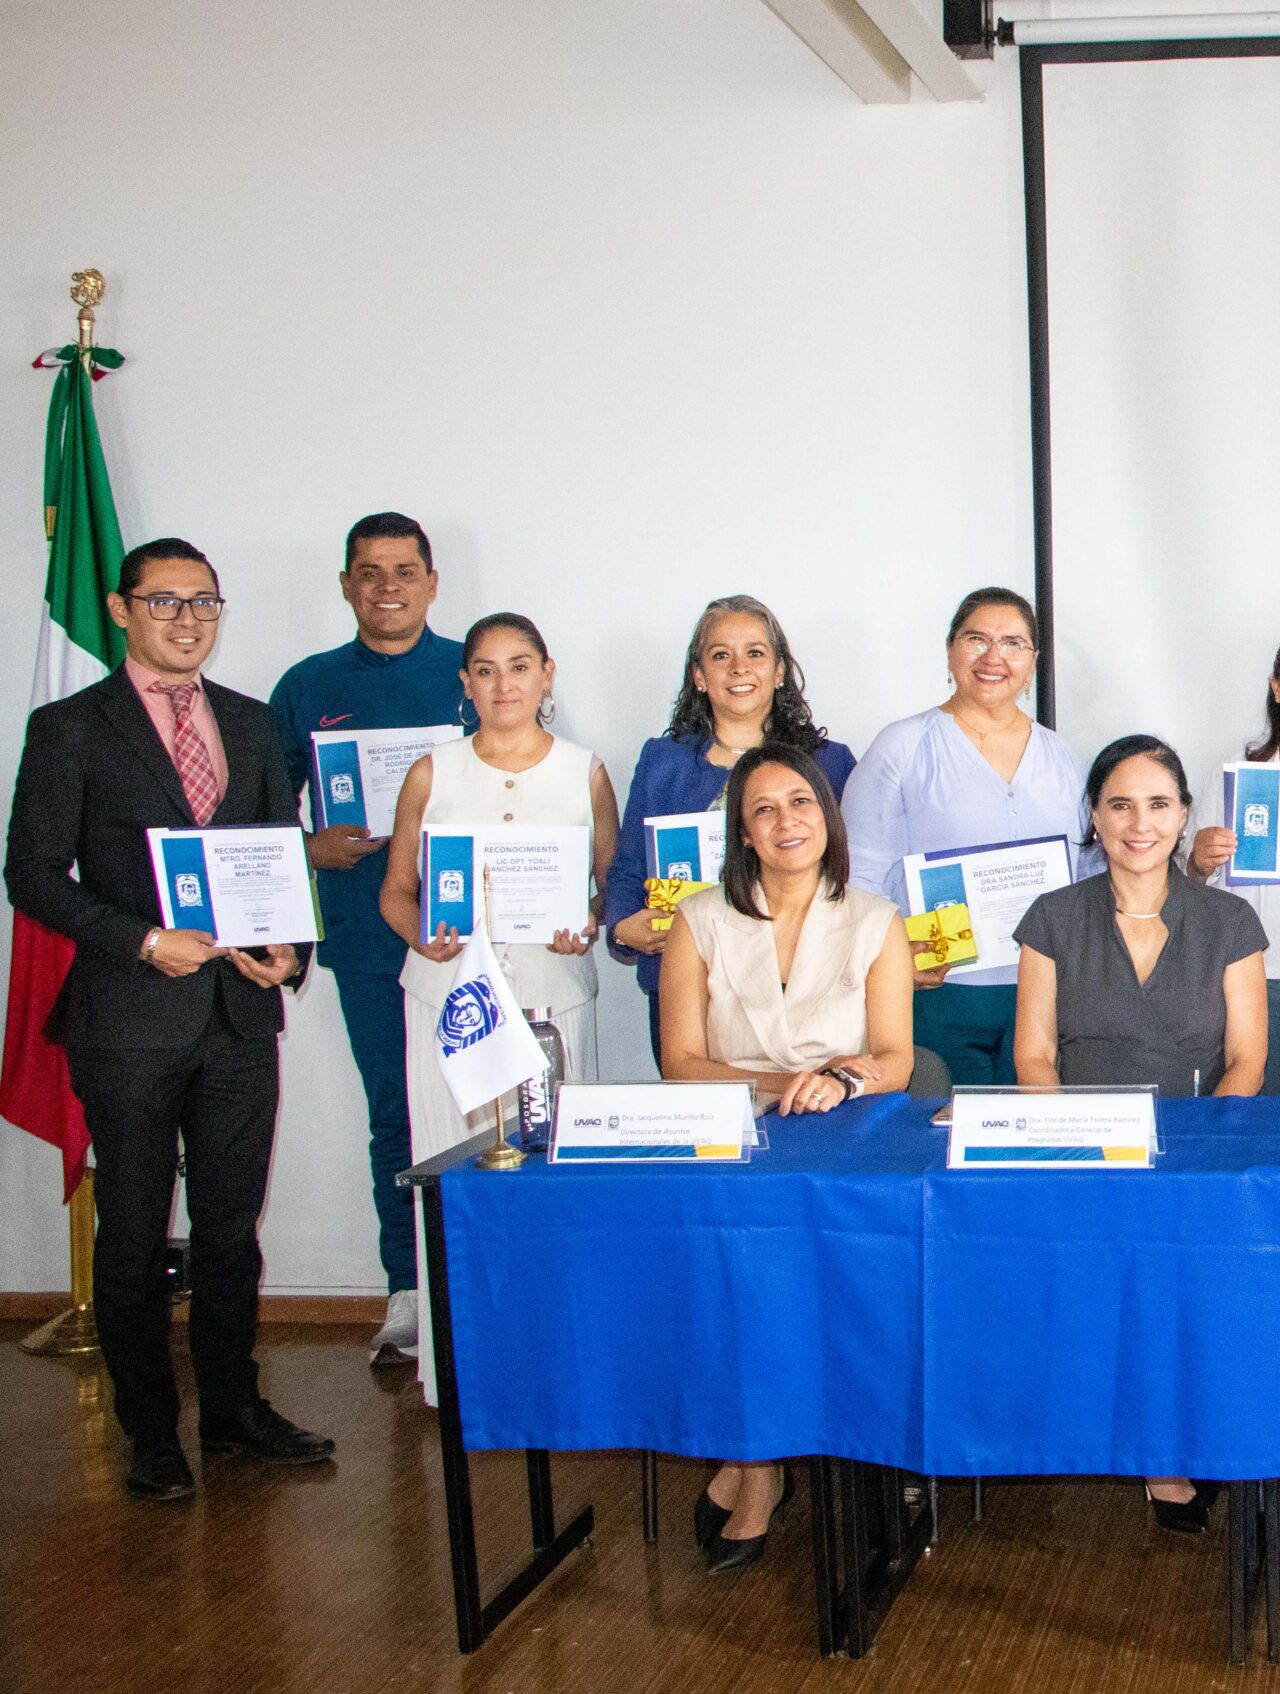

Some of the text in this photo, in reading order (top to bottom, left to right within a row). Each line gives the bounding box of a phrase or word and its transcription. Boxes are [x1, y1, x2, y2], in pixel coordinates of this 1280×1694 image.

[368, 742, 435, 756] RECONOCIMIENTO
[404, 752, 414, 760] DE
[214, 845, 284, 854] RECONOCIMIENTO
[973, 860, 1047, 878] RECONOCIMIENTO
[1031, 869, 1045, 877] LUZ
[574, 1118, 602, 1126] UVAQ
[637, 1114, 672, 1122] Jacqueline
[620, 1128, 652, 1136] Directora
[620, 1137, 671, 1145] Internacionales
[691, 1137, 712, 1145] UVAQ
